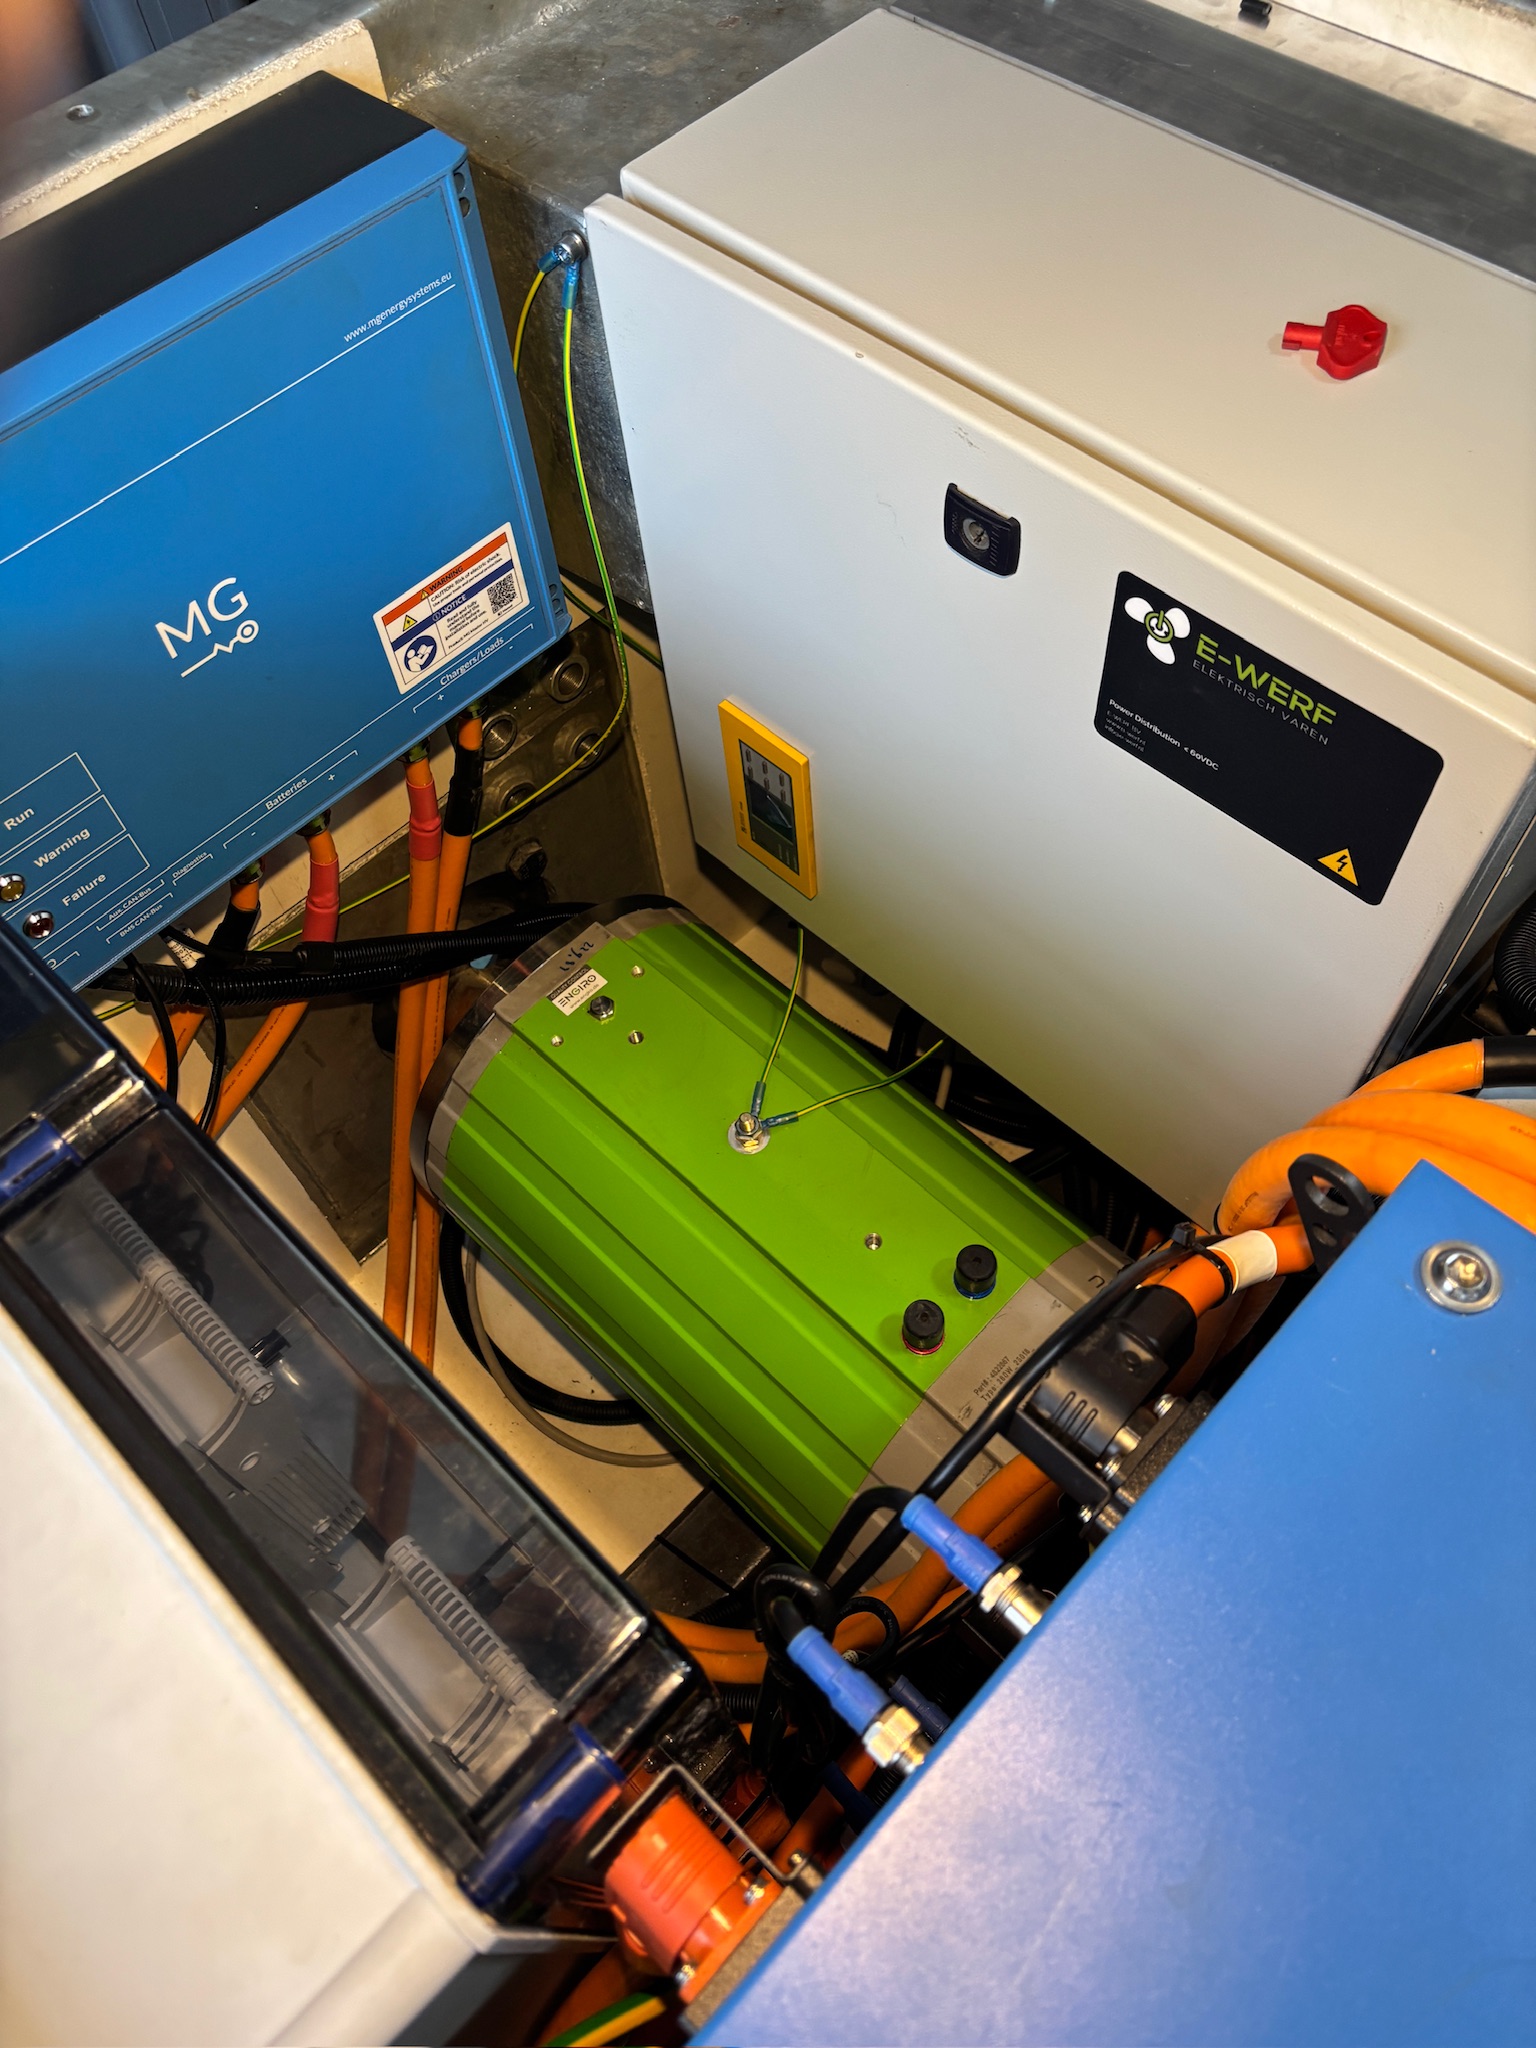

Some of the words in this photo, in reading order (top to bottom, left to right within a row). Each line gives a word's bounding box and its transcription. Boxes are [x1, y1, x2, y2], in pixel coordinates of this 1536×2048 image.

[344, 271, 452, 342] www.mgenergysystems.eu
[429, 566, 464, 592] WARNING
[455, 576, 465, 585] Risk
[470, 562, 487, 575] electric
[155, 577, 249, 659] MG
[441, 594, 467, 616] NOTICE
[447, 612, 458, 623] Read
[459, 607, 467, 615] and
[466, 600, 477, 609] fully
[447, 609, 472, 628] understand
[449, 619, 466, 631] manual
[465, 609, 480, 621] before
[469, 615, 478, 624] and
[440, 636, 505, 686] Chargers/Loads
[1196, 633, 1337, 725] E-WERF
[1192, 659, 1276, 713] ELEKTRISCH
[1281, 710, 1329, 746] VAREN
[1109, 699, 1134, 718] Power
[1134, 714, 1181, 748] Distribution
[264, 777, 308, 811] Batteries
[4, 806, 35, 831] Run
[33, 827, 91, 869] Warning
[172, 851, 208, 878] Diagnostics
[61, 872, 107, 907] Failure
[122, 887, 152, 909] CAN-Bus
[119, 924, 135, 938] BMS
[134, 904, 163, 926] CAN-Bus
[567, 967, 589, 985] CONTROL
[558, 975, 597, 1008] ENGIRO
